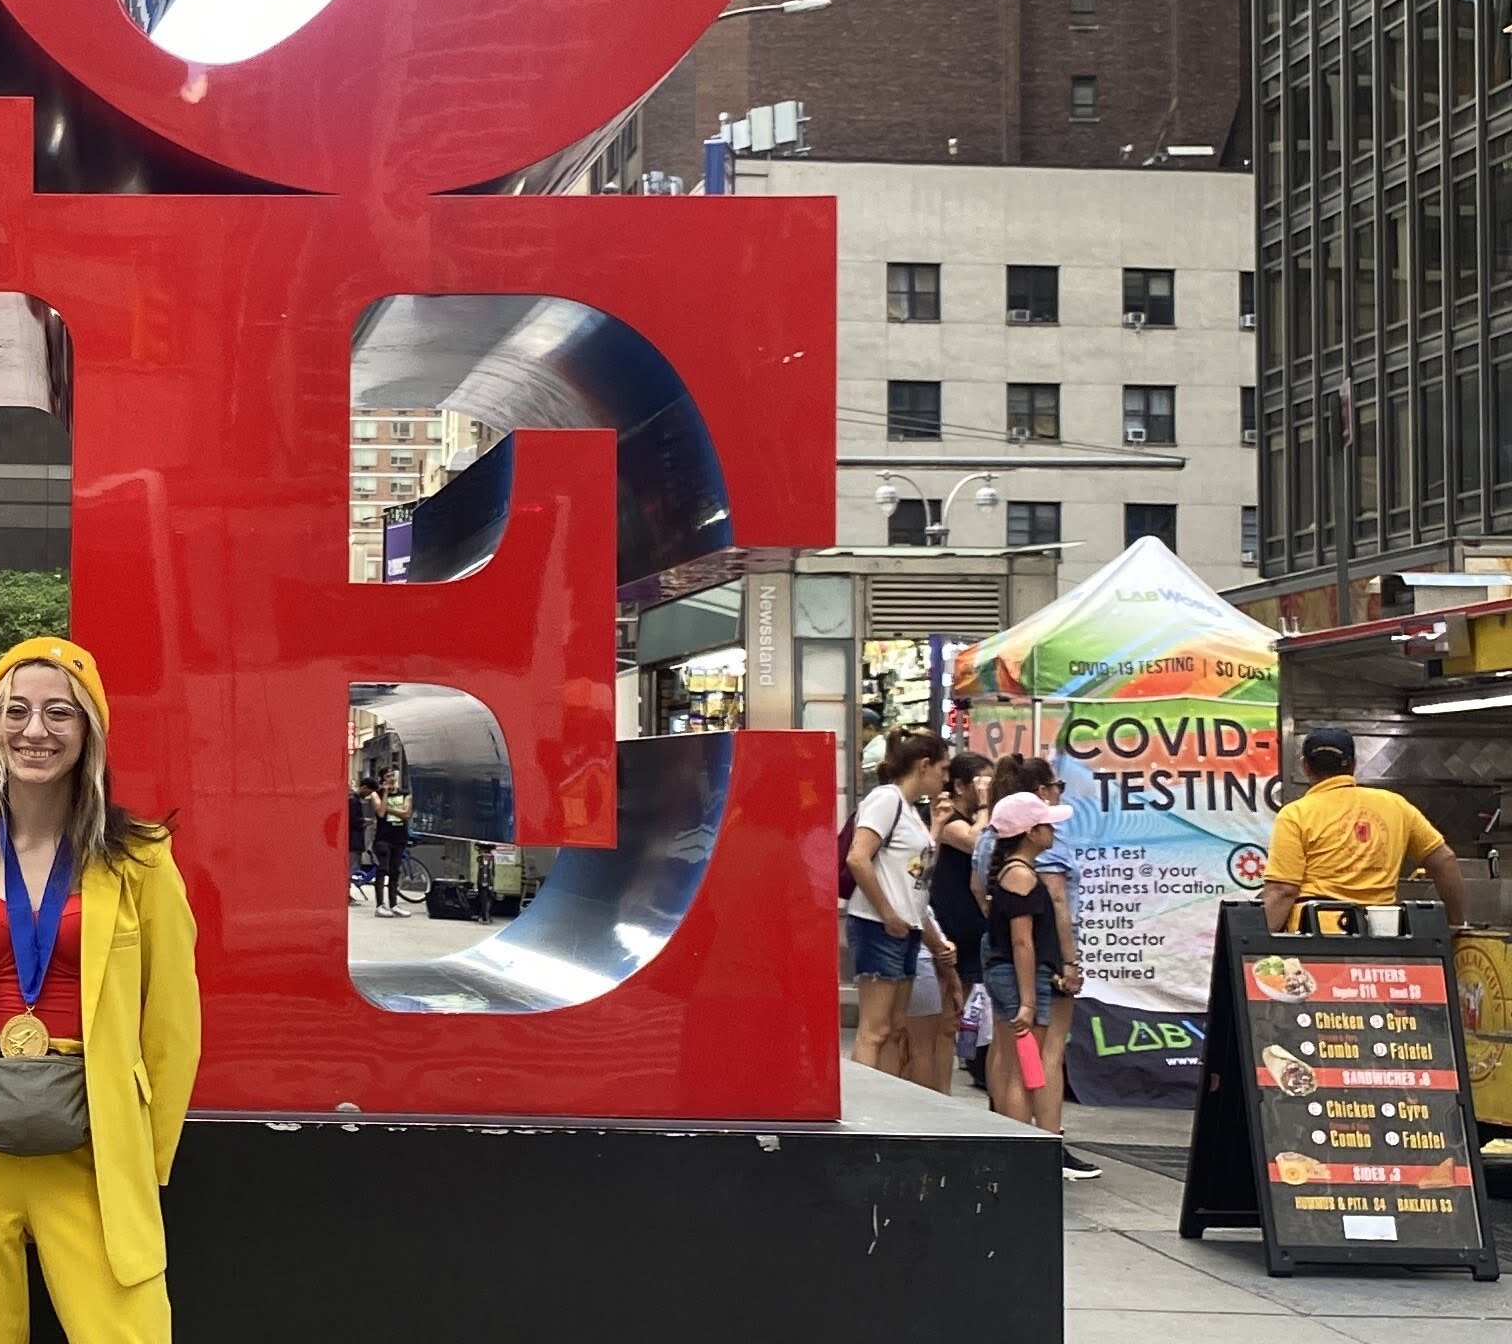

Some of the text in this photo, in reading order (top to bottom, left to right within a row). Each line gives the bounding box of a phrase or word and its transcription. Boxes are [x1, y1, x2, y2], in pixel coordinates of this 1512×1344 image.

[758, 584, 776, 688] Newsstand
[1138, 655, 1194, 676] TESTING
[1075, 846, 1147, 861] PCR Test
[1080, 863, 1198, 881] esting @ your
[1154, 880, 1225, 895] location
[1100, 899, 1143, 913] Hour
[1105, 932, 1166, 946] Doctor
[1349, 967, 1407, 983] PLATTERS
[1314, 1011, 1365, 1030] Chicken
[1386, 1012, 1417, 1033] Gyro
[1318, 1040, 1360, 1059] Combo
[1389, 1042, 1433, 1060] Falafel
[1341, 1070, 1416, 1087] SANDWICHES
[1325, 1099, 1376, 1119] Chicken
[1398, 1101, 1429, 1122] Gyro
[1329, 1129, 1372, 1148] Combo
[1402, 1130, 1446, 1149] Falafel
[1352, 1166, 1387, 1182] SIDES
[1337, 1196, 1346, 1211] &
[1347, 1196, 1369, 1211] PITA
[1396, 1197, 1439, 1213] BAKLAVA
